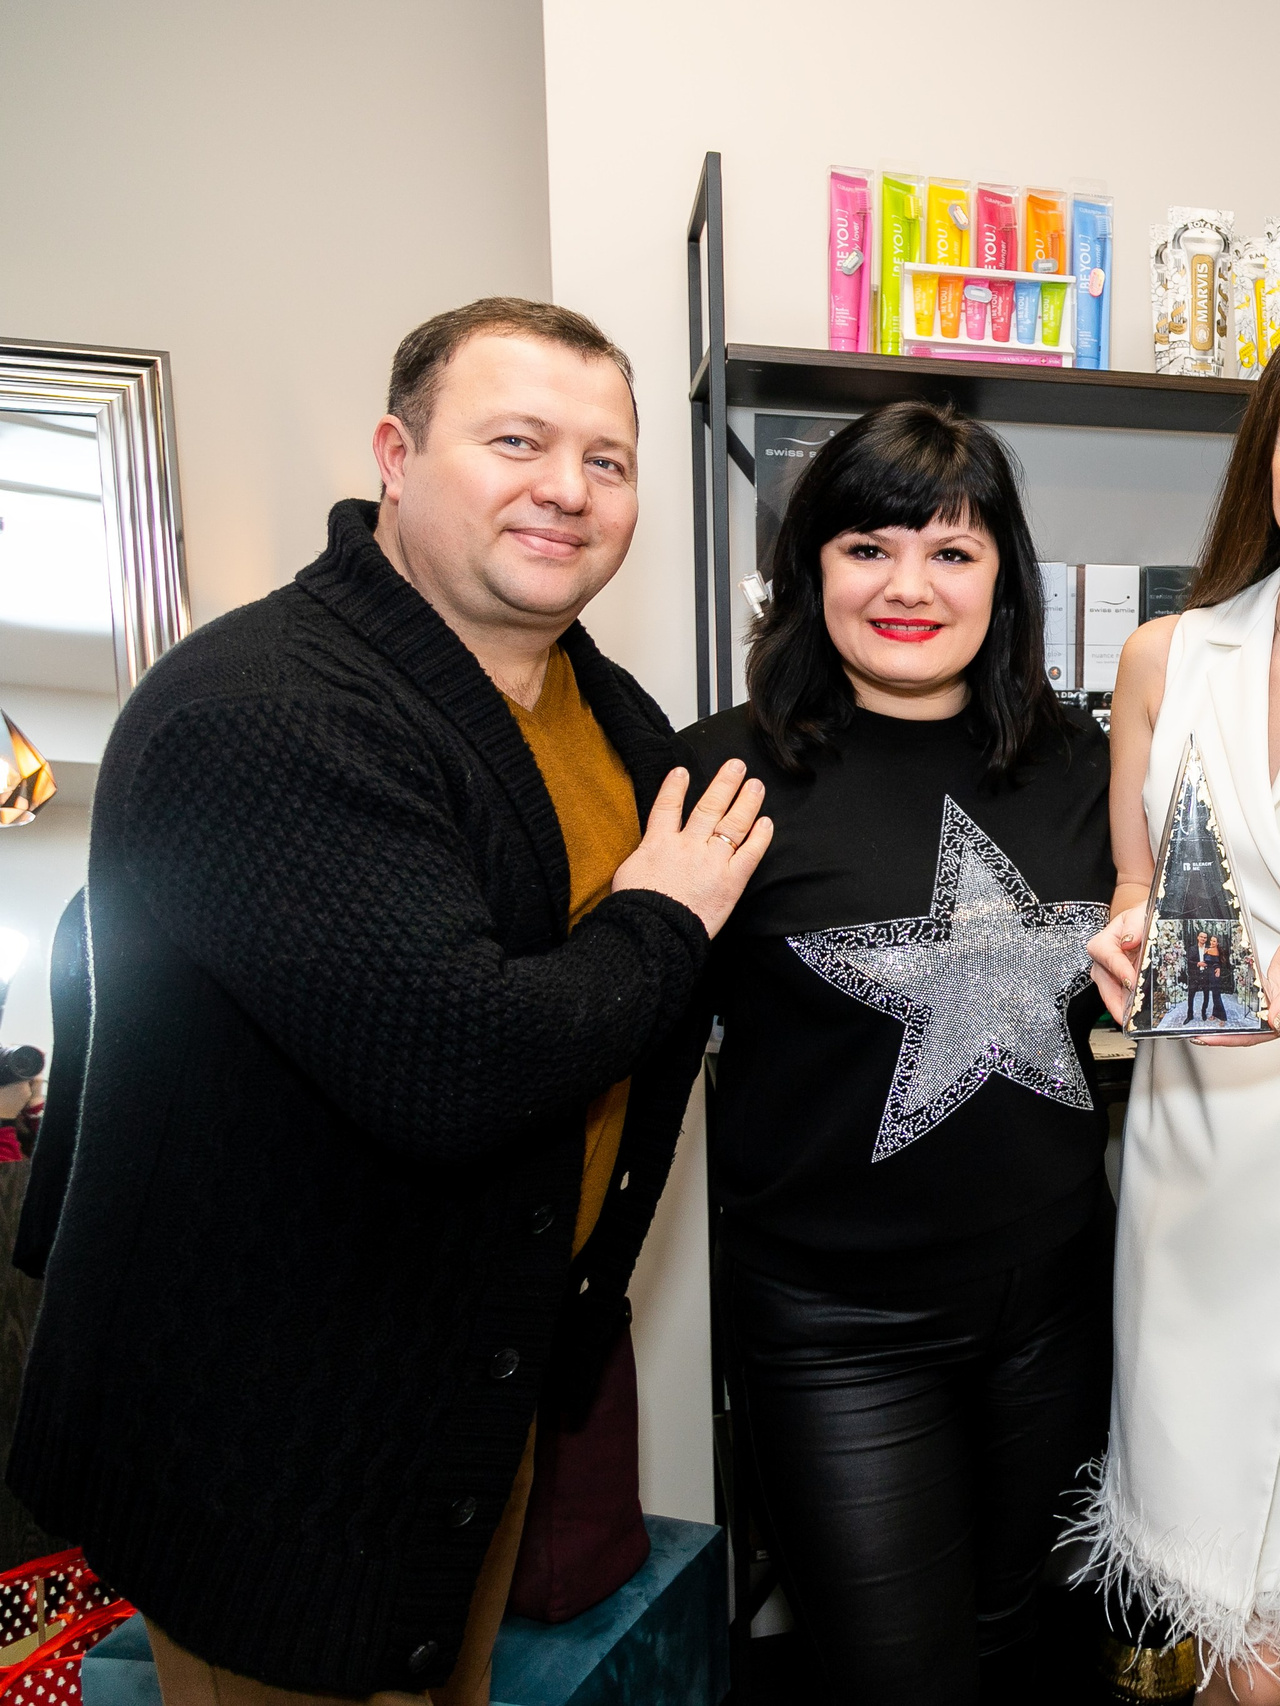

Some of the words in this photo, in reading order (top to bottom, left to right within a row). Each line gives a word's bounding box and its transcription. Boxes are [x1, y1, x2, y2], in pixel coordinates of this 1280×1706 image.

[1188, 221, 1218, 232] ROYAL
[1033, 230, 1046, 260] OU.]
[1196, 262, 1209, 323] MARVIS
[765, 447, 804, 458] swiss
